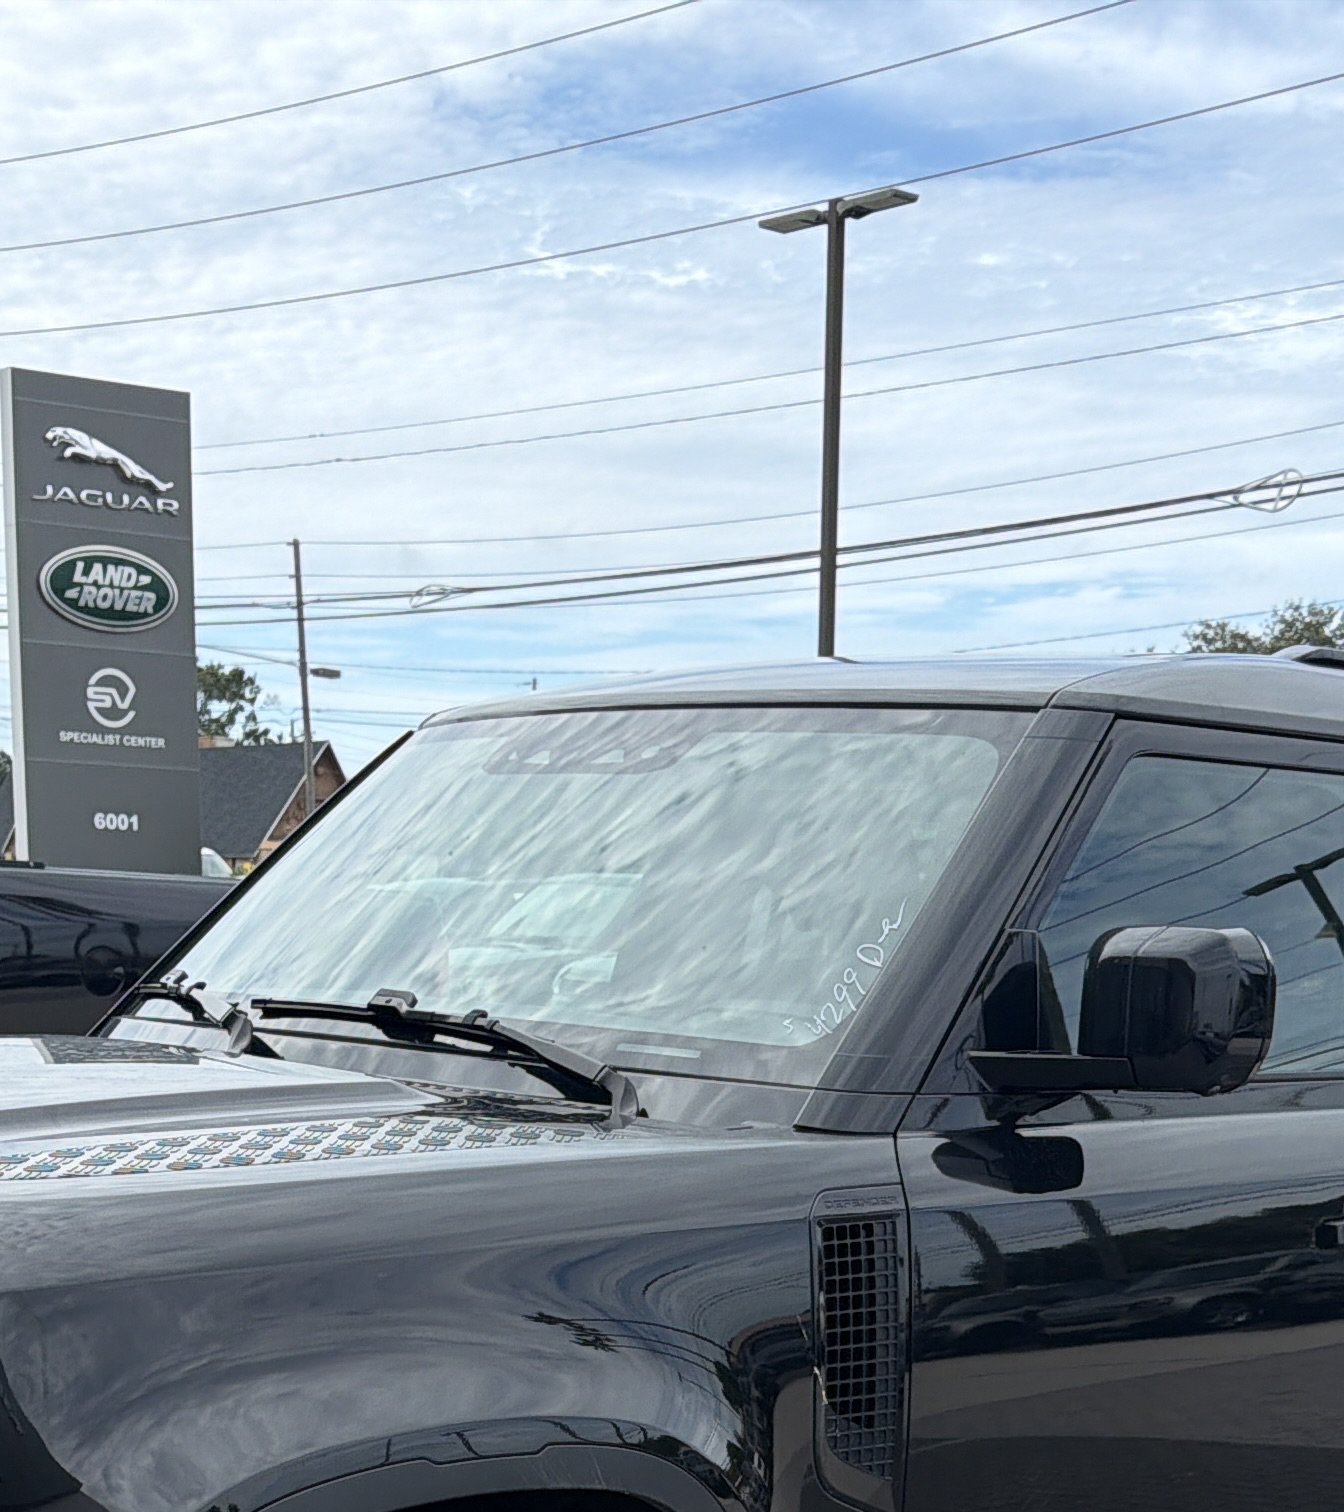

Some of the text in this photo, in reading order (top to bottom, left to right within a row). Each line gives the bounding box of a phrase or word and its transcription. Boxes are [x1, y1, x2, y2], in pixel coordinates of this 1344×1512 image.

[32, 484, 180, 516] JAGUAR
[73, 560, 138, 587] LAND
[78, 587, 157, 614] ROVER
[59, 730, 166, 749] SPECIALIST CENTER
[93, 812, 139, 832] 6001
